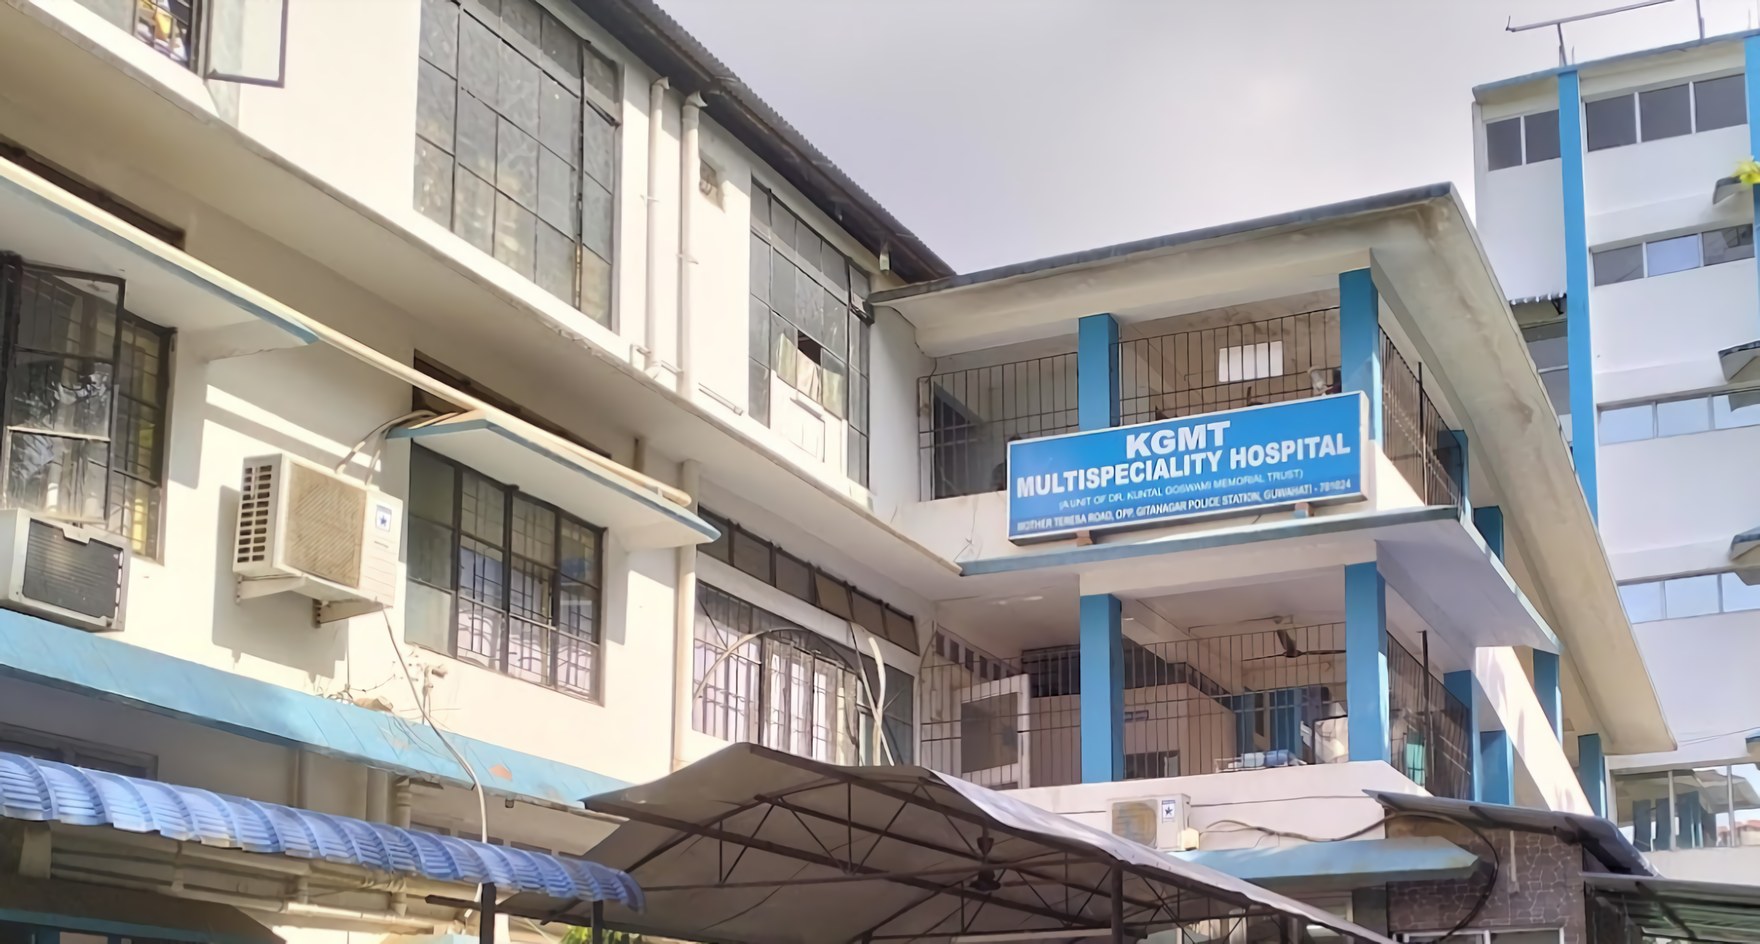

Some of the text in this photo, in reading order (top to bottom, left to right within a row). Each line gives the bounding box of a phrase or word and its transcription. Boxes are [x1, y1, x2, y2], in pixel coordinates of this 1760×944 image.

[1126, 420, 1231, 459] KGMT
[1016, 433, 1351, 498] MULTISPECIALITY HOSPITAL
[1016, 517, 1052, 531] MOTHER
[1053, 513, 1087, 526] TERESA
[1135, 500, 1187, 517] GITANAGAR
[1187, 495, 1221, 511] POLICE
[1263, 484, 1313, 501] GUWAHATI
[1070, 498, 1091, 509] UNIT
[1093, 496, 1105, 505] OF
[1126, 487, 1163, 502] KUNTAL
[1213, 474, 1265, 489] MEMORIAL
[1267, 468, 1304, 482] TRUST)
